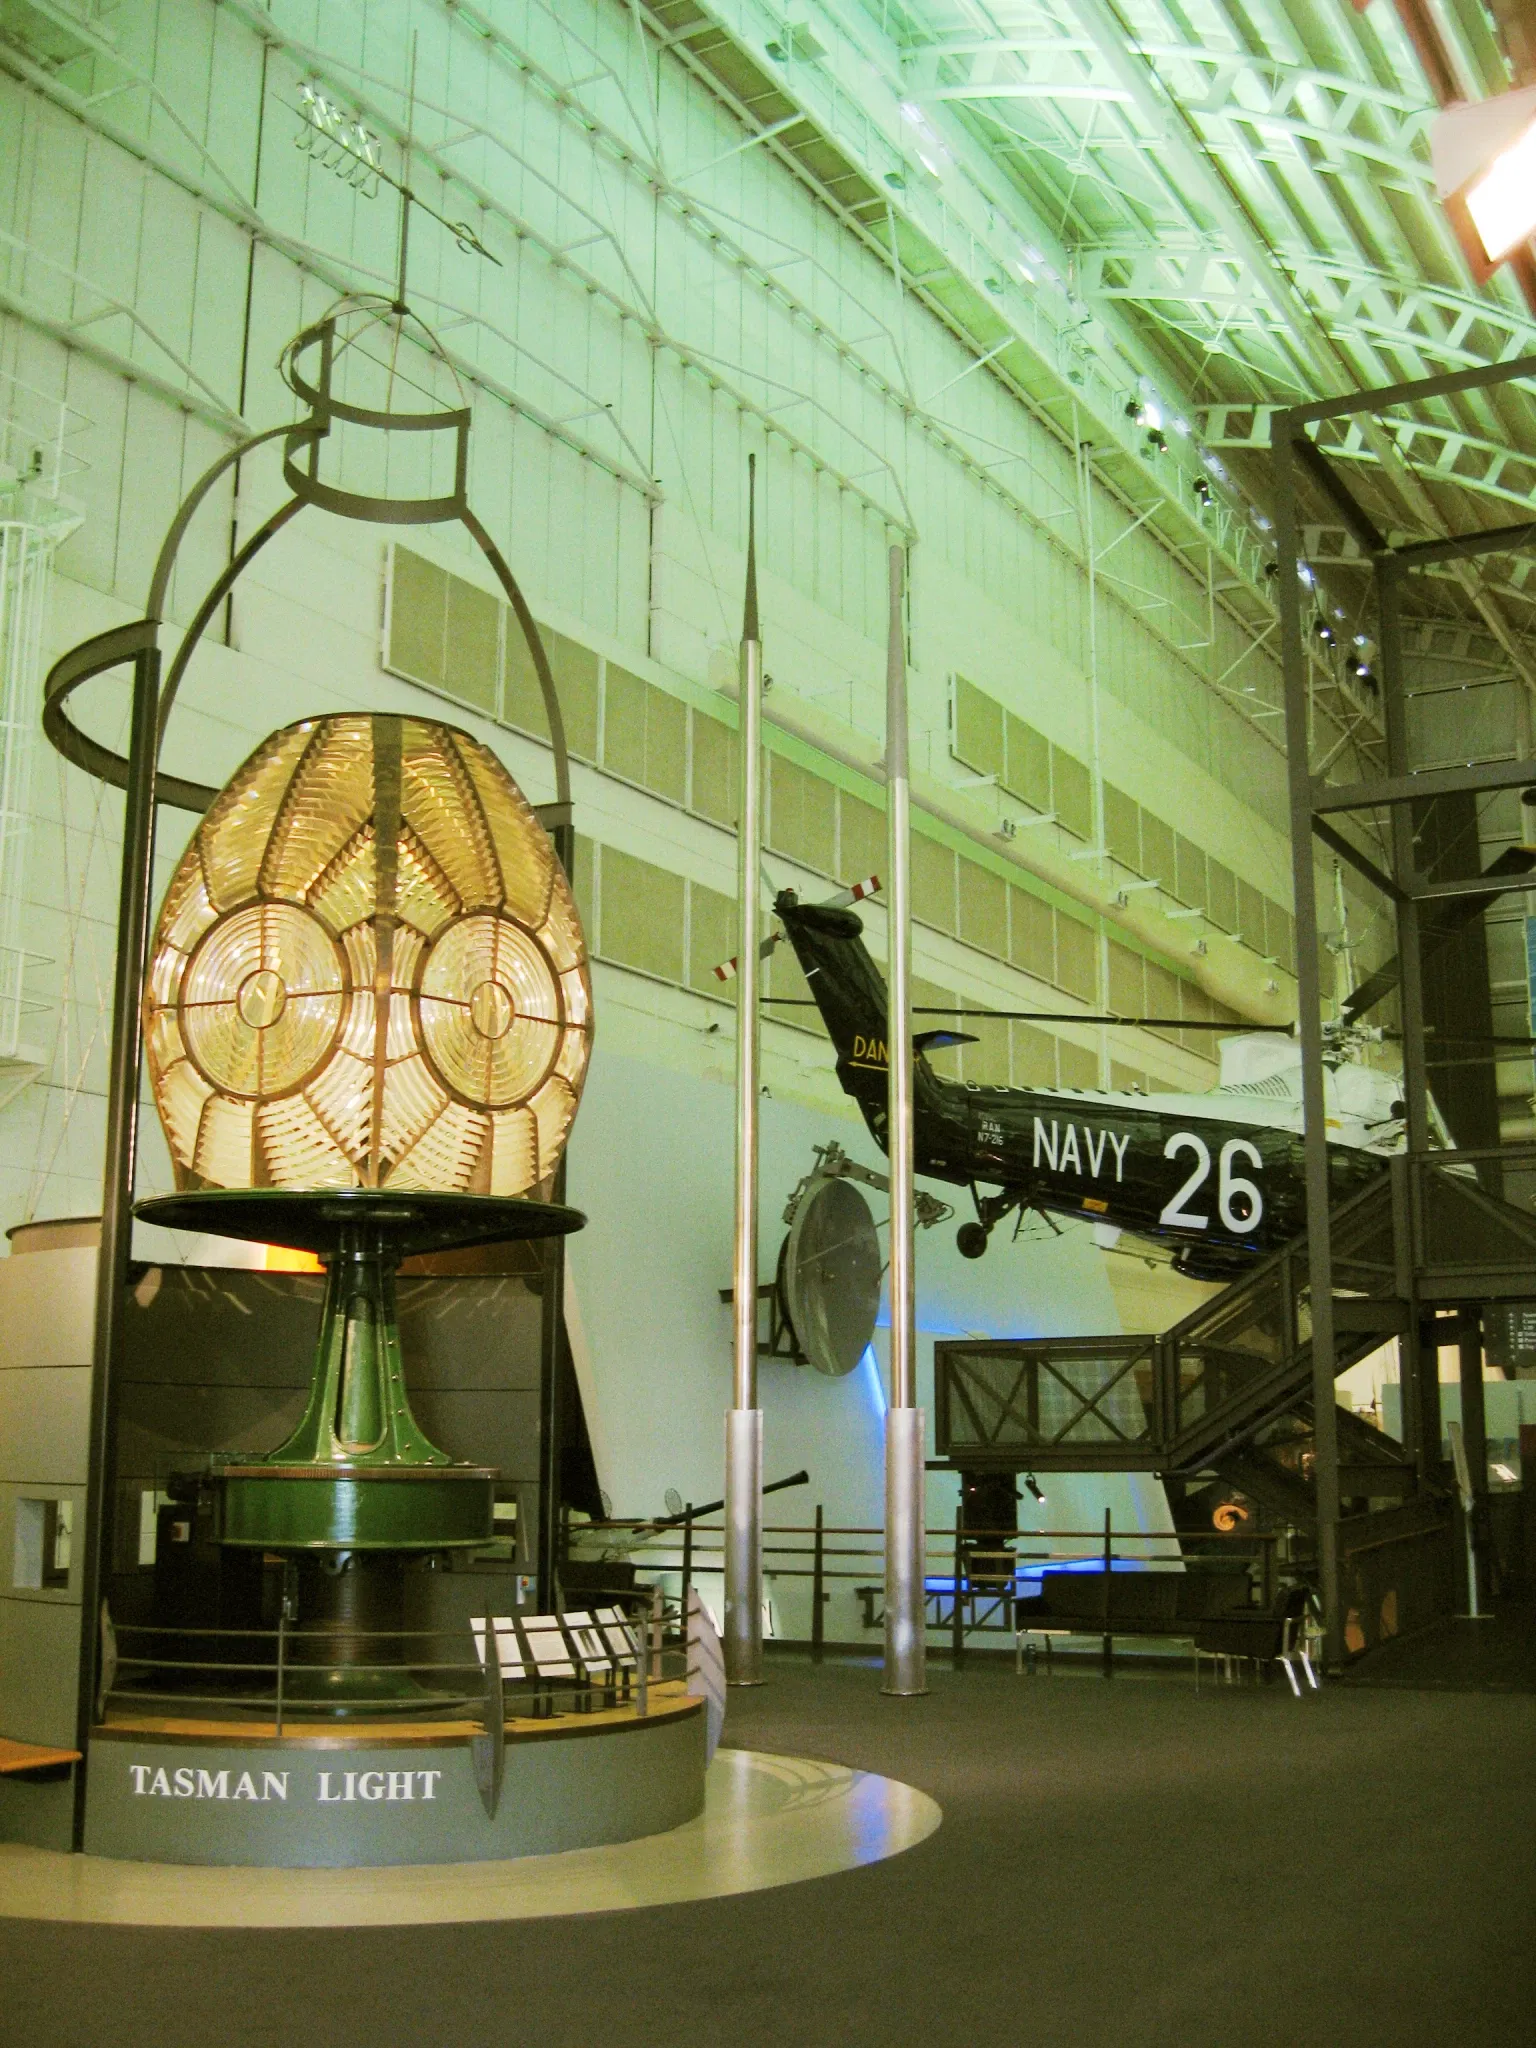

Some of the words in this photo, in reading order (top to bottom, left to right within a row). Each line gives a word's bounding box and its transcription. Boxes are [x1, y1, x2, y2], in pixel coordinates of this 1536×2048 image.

[1033, 1116, 1131, 1183] NAVY
[1159, 1132, 1264, 1234] 26
[130, 1765, 290, 1800] TASMAN
[317, 1770, 442, 1801] LIGHT
